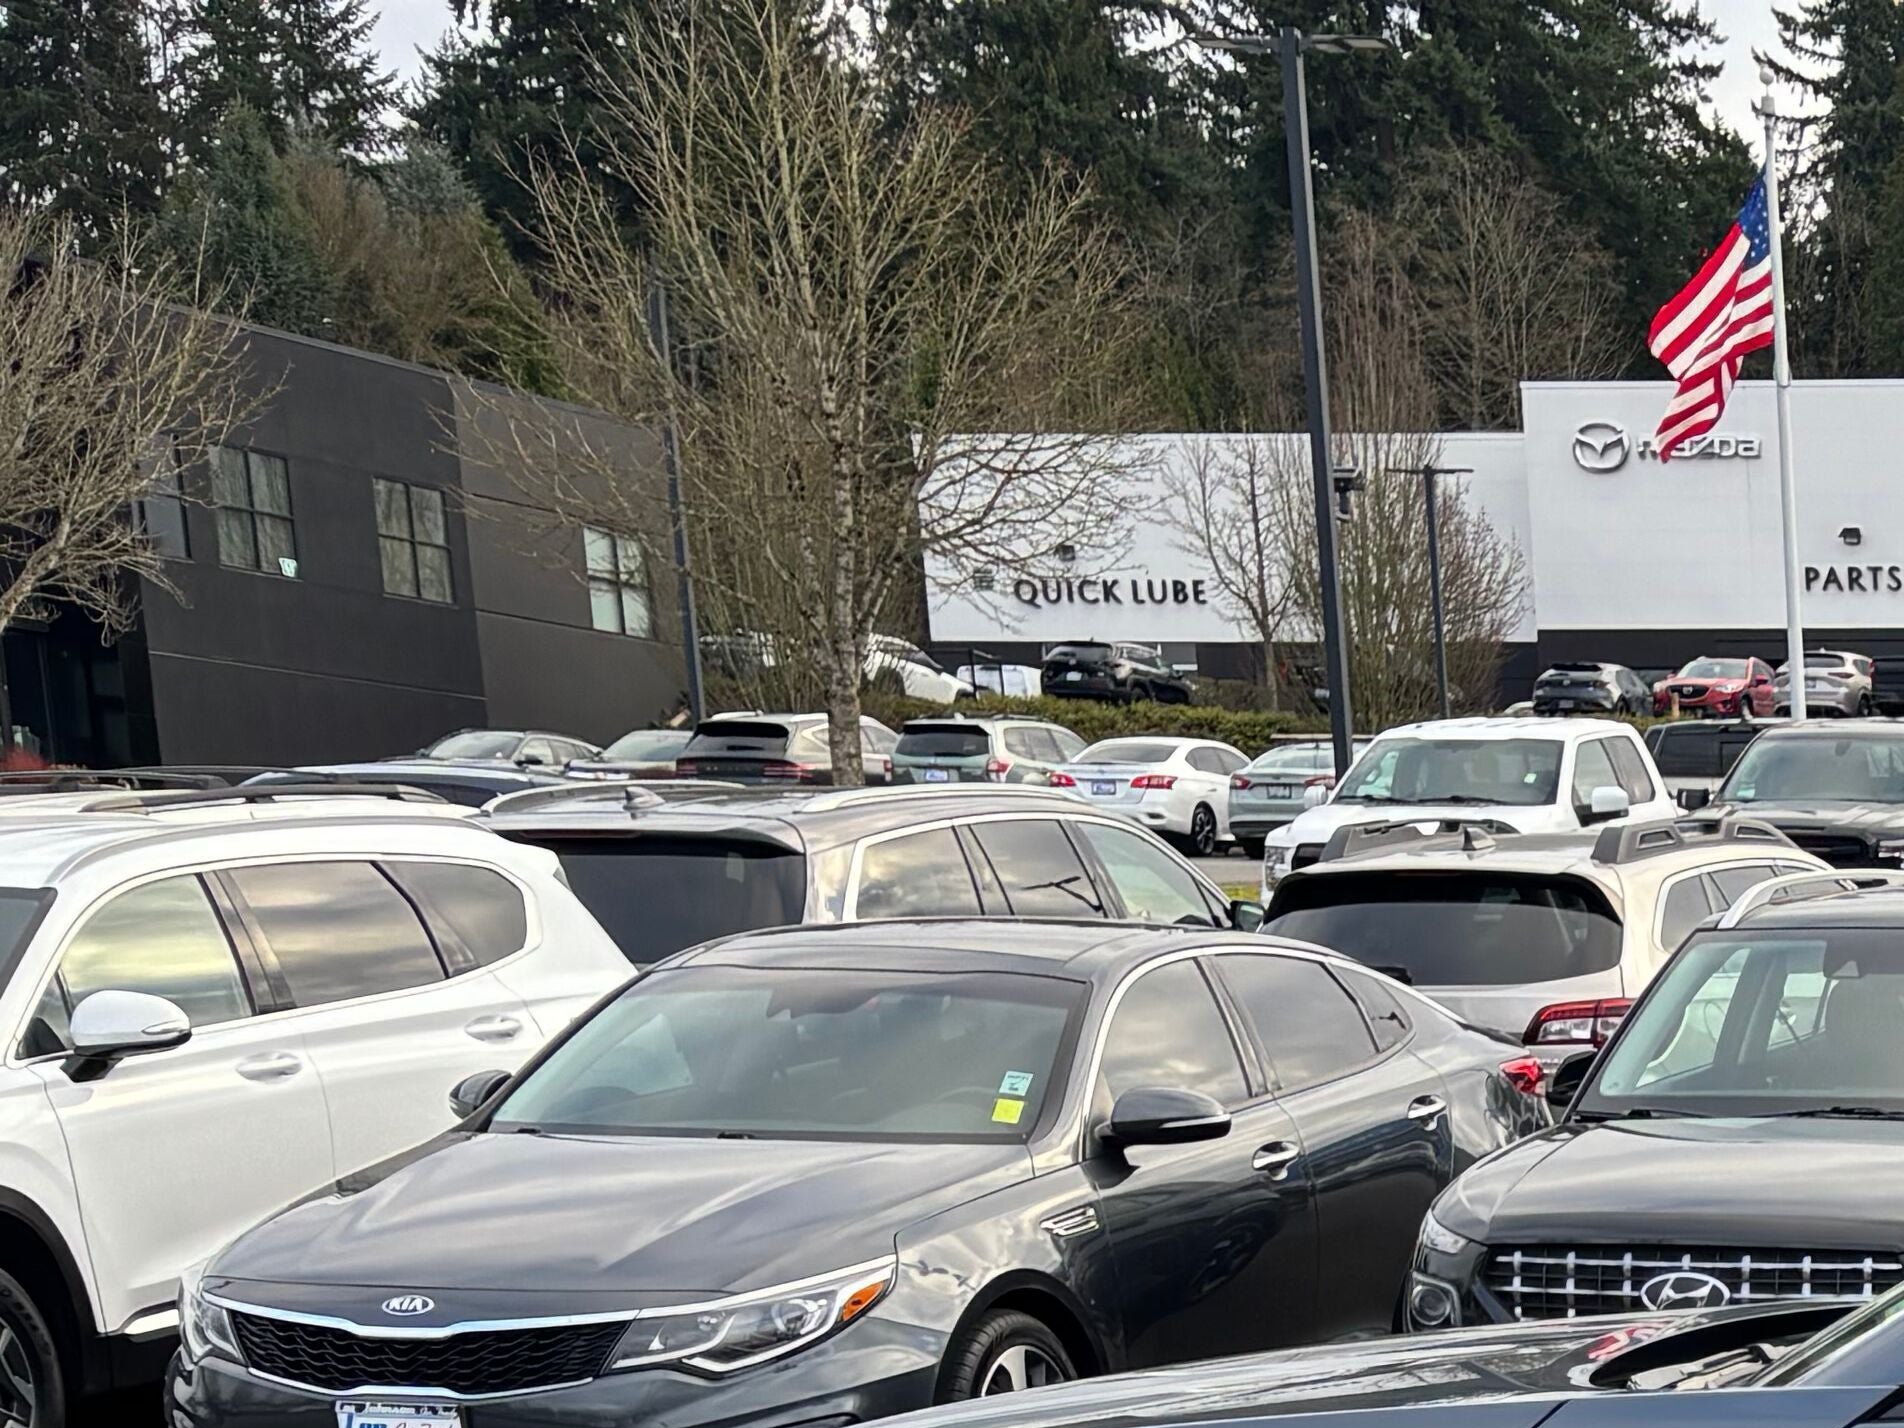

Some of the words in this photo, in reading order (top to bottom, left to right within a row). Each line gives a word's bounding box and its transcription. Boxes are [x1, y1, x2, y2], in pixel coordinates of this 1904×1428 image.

[1804, 566, 1903, 592] PARTS
[1014, 578, 1122, 609] QUICK
[1131, 578, 1208, 604] LUBE
[388, 1295, 423, 1311] KIA
